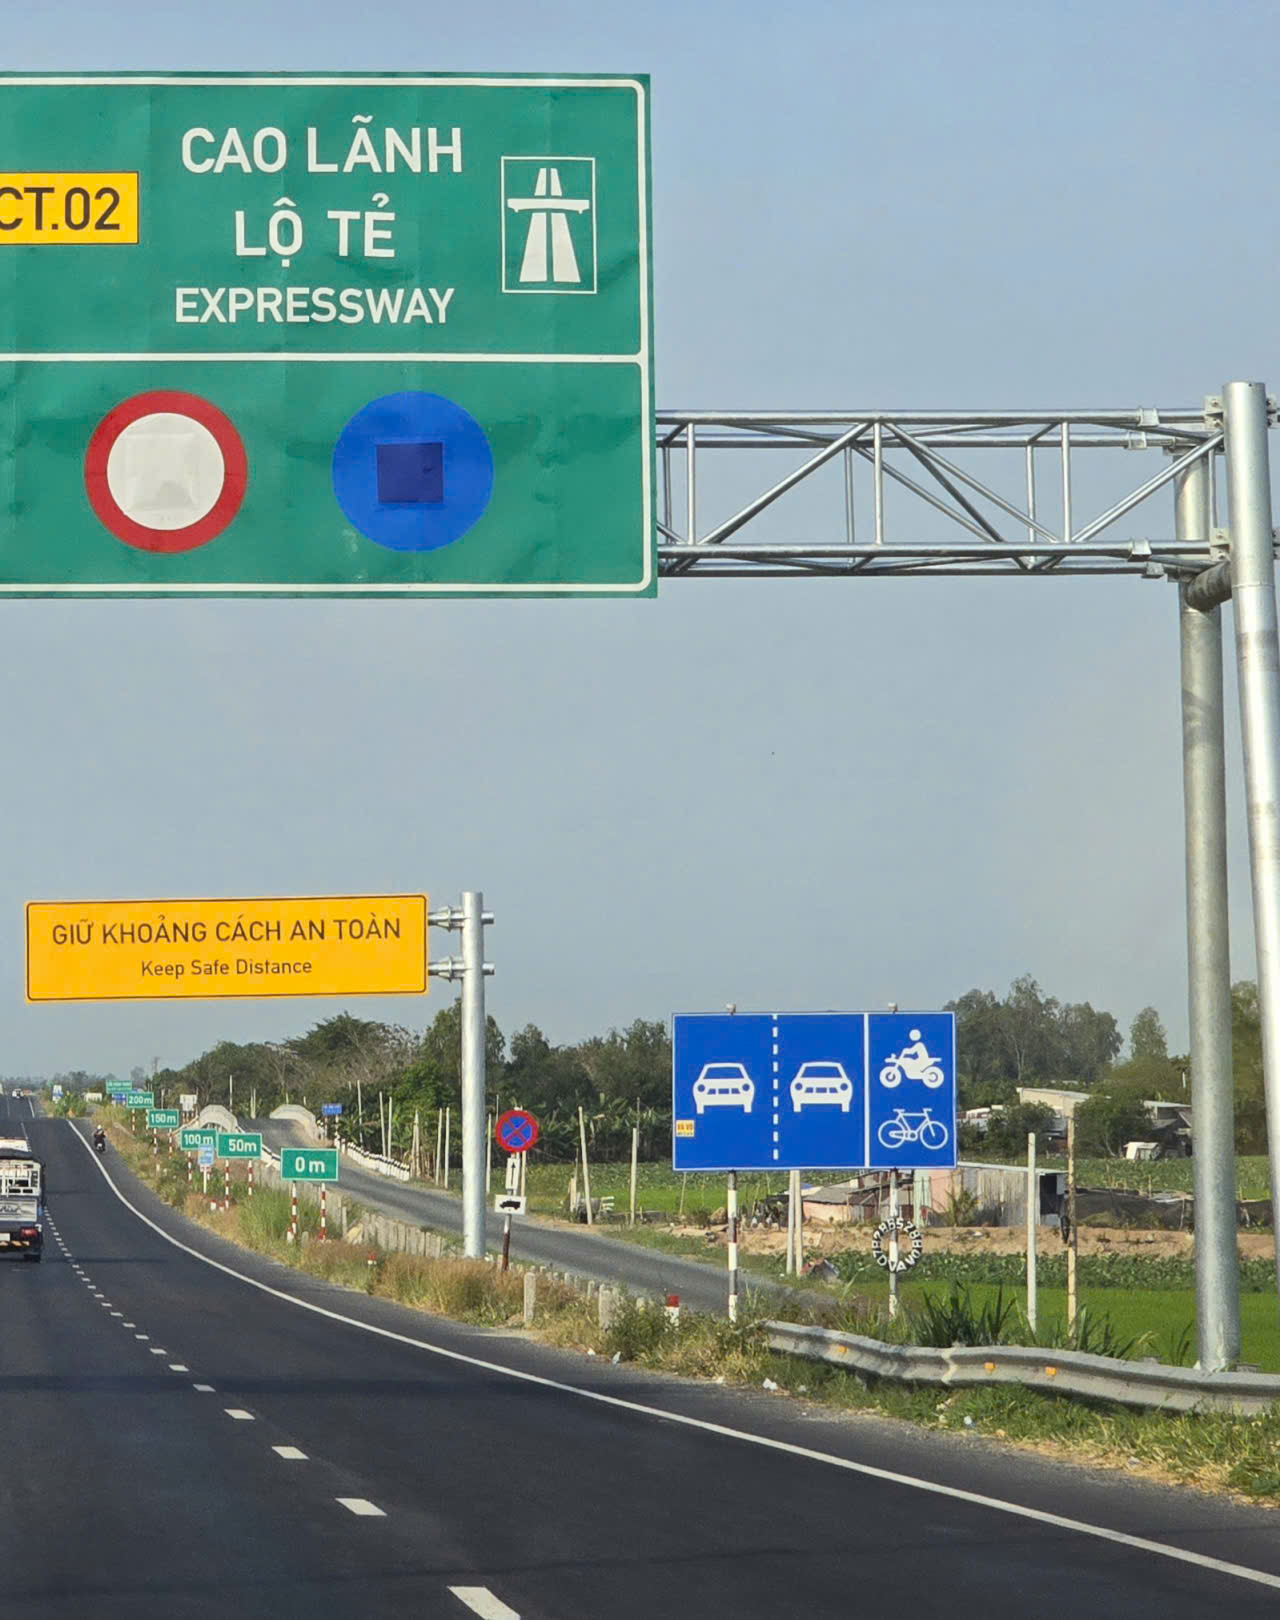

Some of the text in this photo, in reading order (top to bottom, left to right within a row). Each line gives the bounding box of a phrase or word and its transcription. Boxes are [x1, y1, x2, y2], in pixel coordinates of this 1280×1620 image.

[181, 114, 463, 174] CAO LÃNH
[235, 192, 396, 268] LỘ TẺ
[175, 286, 455, 324] EXPRESSWAY
[52, 912, 400, 945] GIỮ KHOẢNG CÁCH AN TOÀN
[141, 958, 313, 980] Keep Safe Distance
[295, 1156, 326, 1173] 0 m
